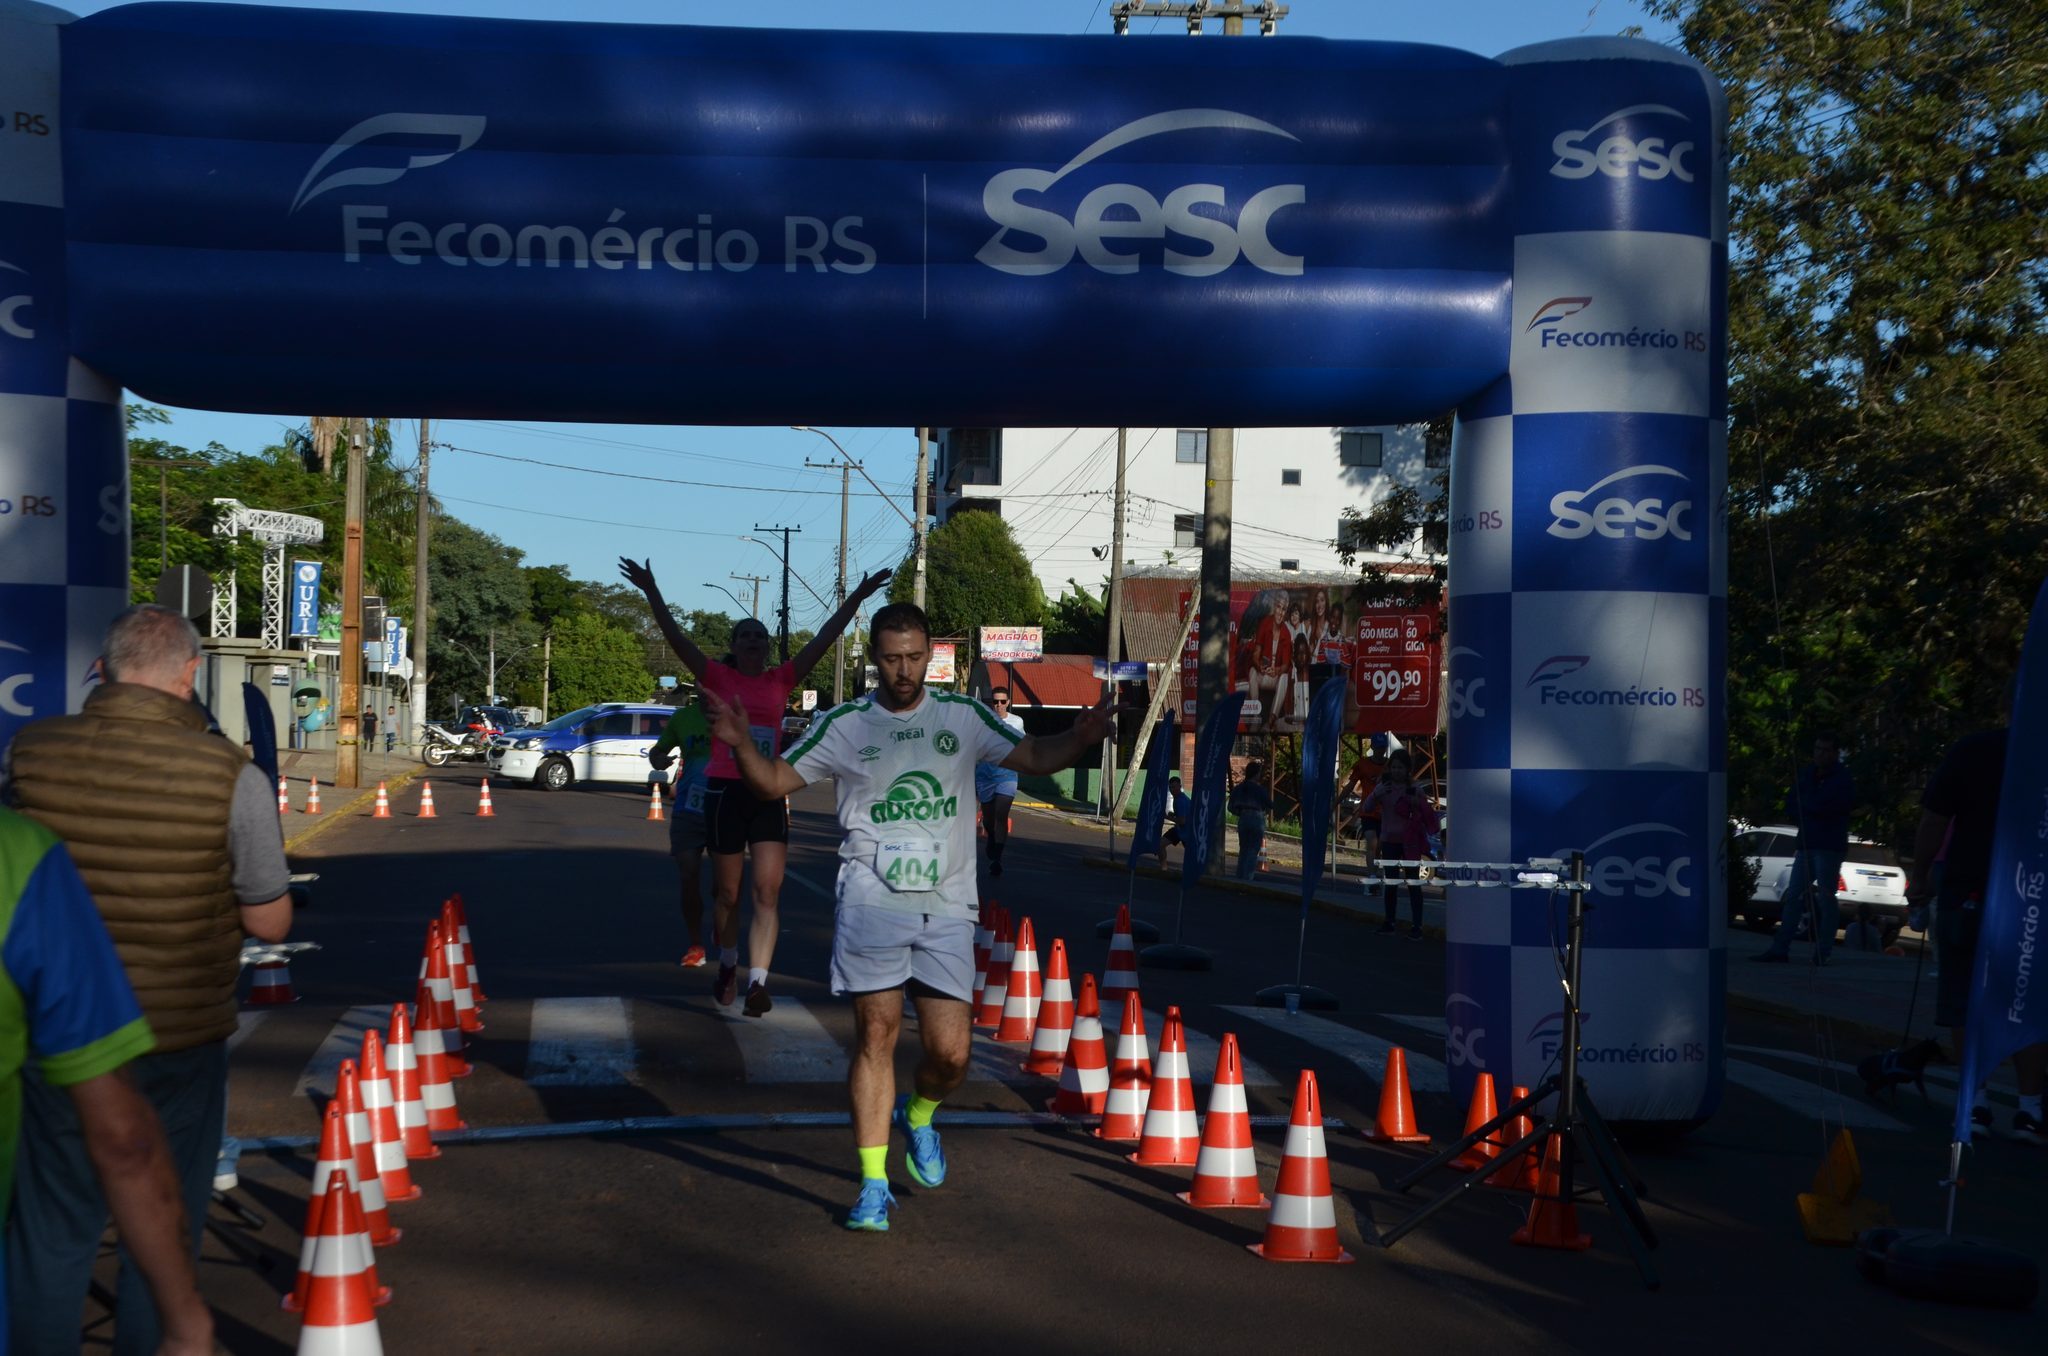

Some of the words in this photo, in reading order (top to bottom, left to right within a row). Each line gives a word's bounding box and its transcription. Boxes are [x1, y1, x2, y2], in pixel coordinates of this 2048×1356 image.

[13, 111, 50, 137] RS
[1549, 129, 1695, 183] Sesc
[973, 167, 1306, 278] Sesc
[341, 205, 760, 275] Fecomércio
[784, 214, 878, 276] RS
[1541, 326, 1679, 349] Fecomércio
[1683, 331, 1706, 352] RS
[21, 495, 57, 517] RS
[1478, 509, 1503, 531] RS
[1546, 490, 1692, 541] Sesc
[298, 585, 315, 633] URI
[1360, 628, 1376, 639] 600
[1376, 627, 1399, 639] MEGA
[1406, 627, 1418, 638] 60
[386, 632, 397, 665] URI
[1541, 685, 1677, 707] Fecomércio
[1682, 687, 1705, 708] RS
[897, 728, 925, 742] Real
[870, 796, 957, 824] aurora
[885, 857, 939, 887] 404
[2026, 870, 2046, 901] RS
[2007, 904, 2041, 1024] Fecomércio
[1683, 1043, 1705, 1063] RS
